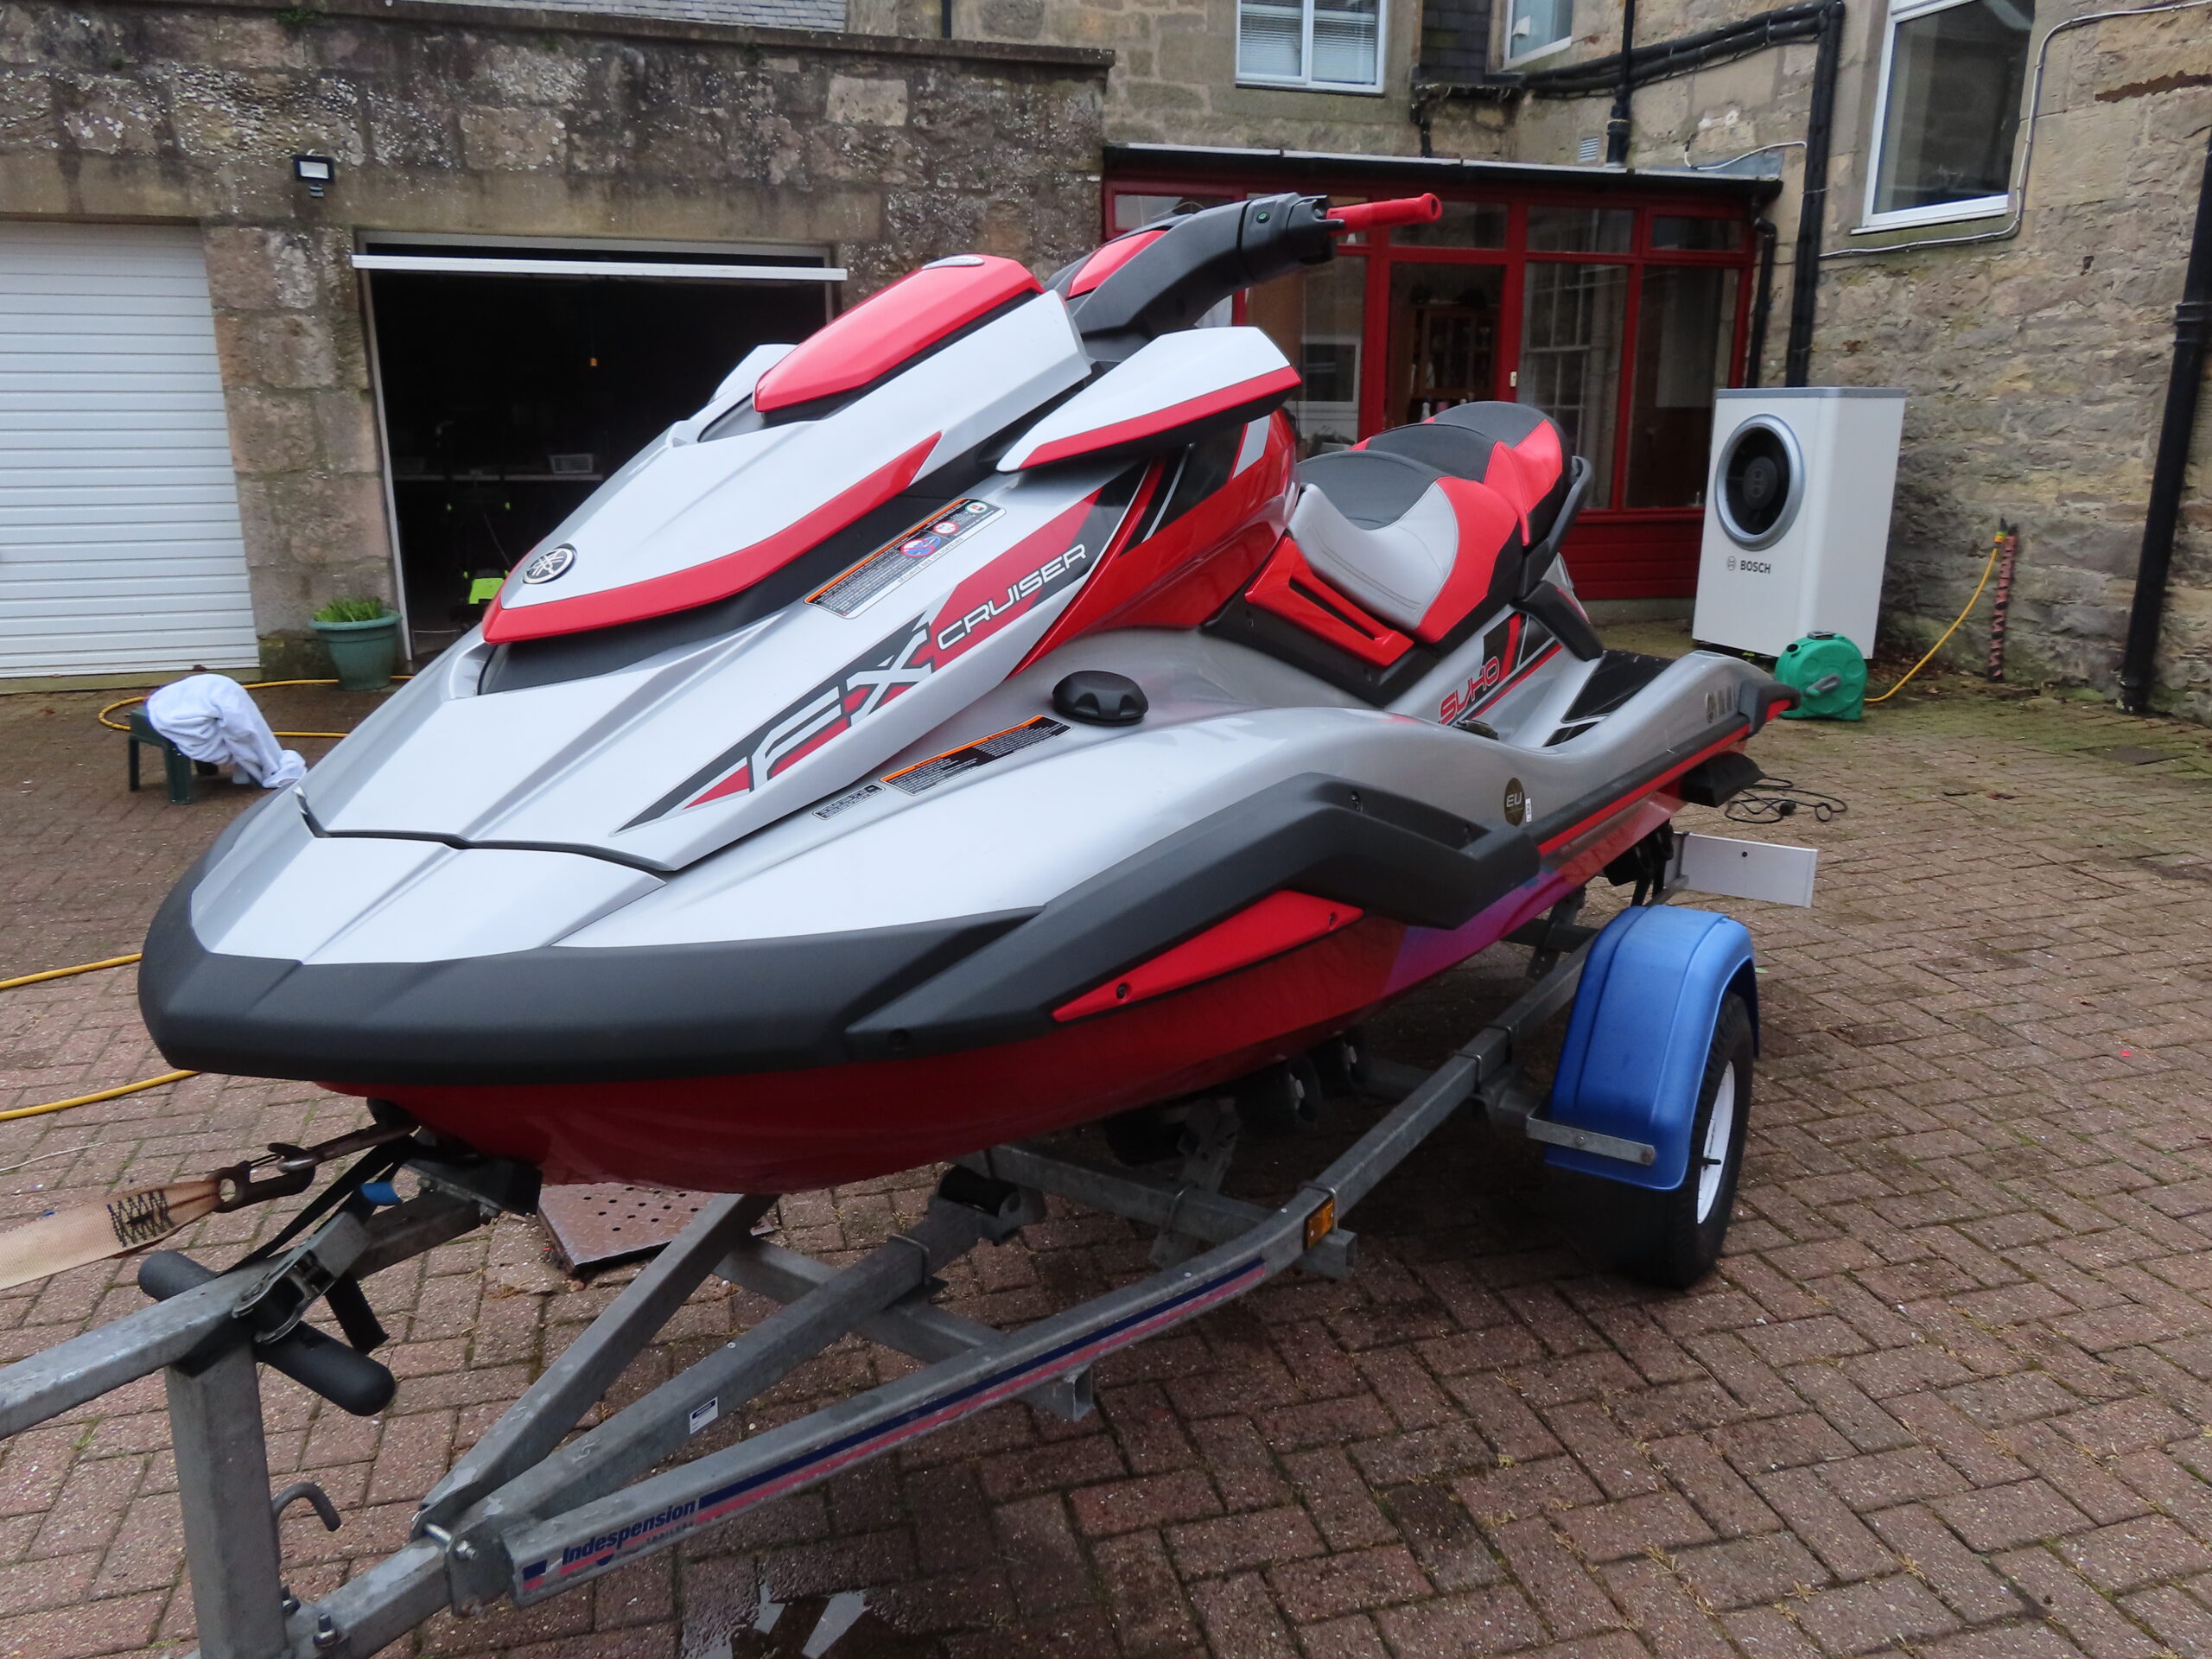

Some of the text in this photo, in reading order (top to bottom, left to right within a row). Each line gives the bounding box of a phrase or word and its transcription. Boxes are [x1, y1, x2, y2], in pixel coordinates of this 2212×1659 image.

[938, 543, 1087, 651] CRUISER
[1740, 559, 1771, 575] BOSCH
[749, 628, 932, 791] FX
[1439, 656, 1500, 726] SVHO
[1506, 791, 1522, 808] EU
[561, 1499, 696, 1567] Indespension
